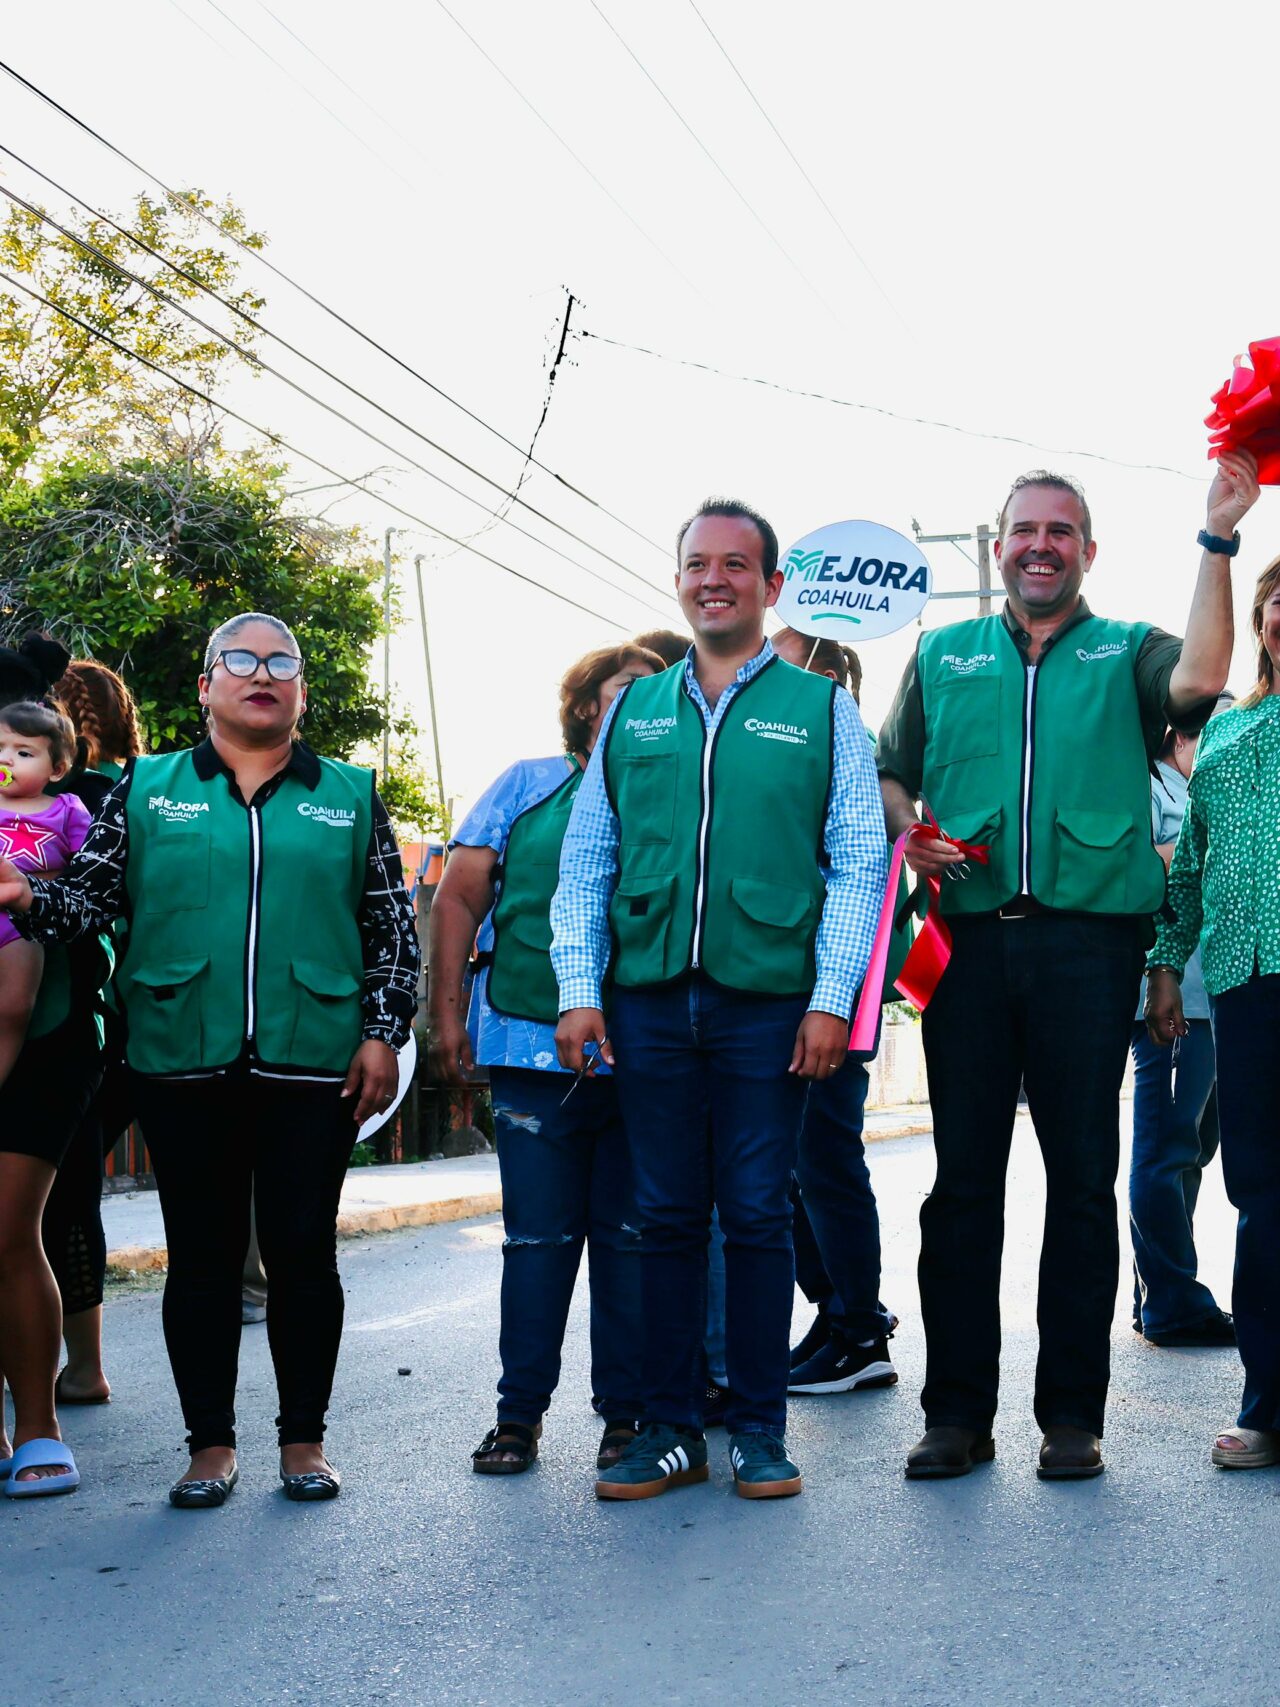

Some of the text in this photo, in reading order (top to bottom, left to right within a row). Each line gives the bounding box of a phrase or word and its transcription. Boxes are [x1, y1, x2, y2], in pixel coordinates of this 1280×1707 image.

[783, 549, 928, 593] MEJORA
[797, 589, 890, 613] COAHUILA
[940, 654, 996, 666] MEJORA
[625, 715, 677, 730] MEJORA
[744, 718, 808, 737] COAHUILA
[634, 728, 669, 737] COAHUILA
[148, 796, 209, 812] MEJORA
[297, 802, 356, 820] COAHUILA
[158, 808, 199, 819] COAHUILA
